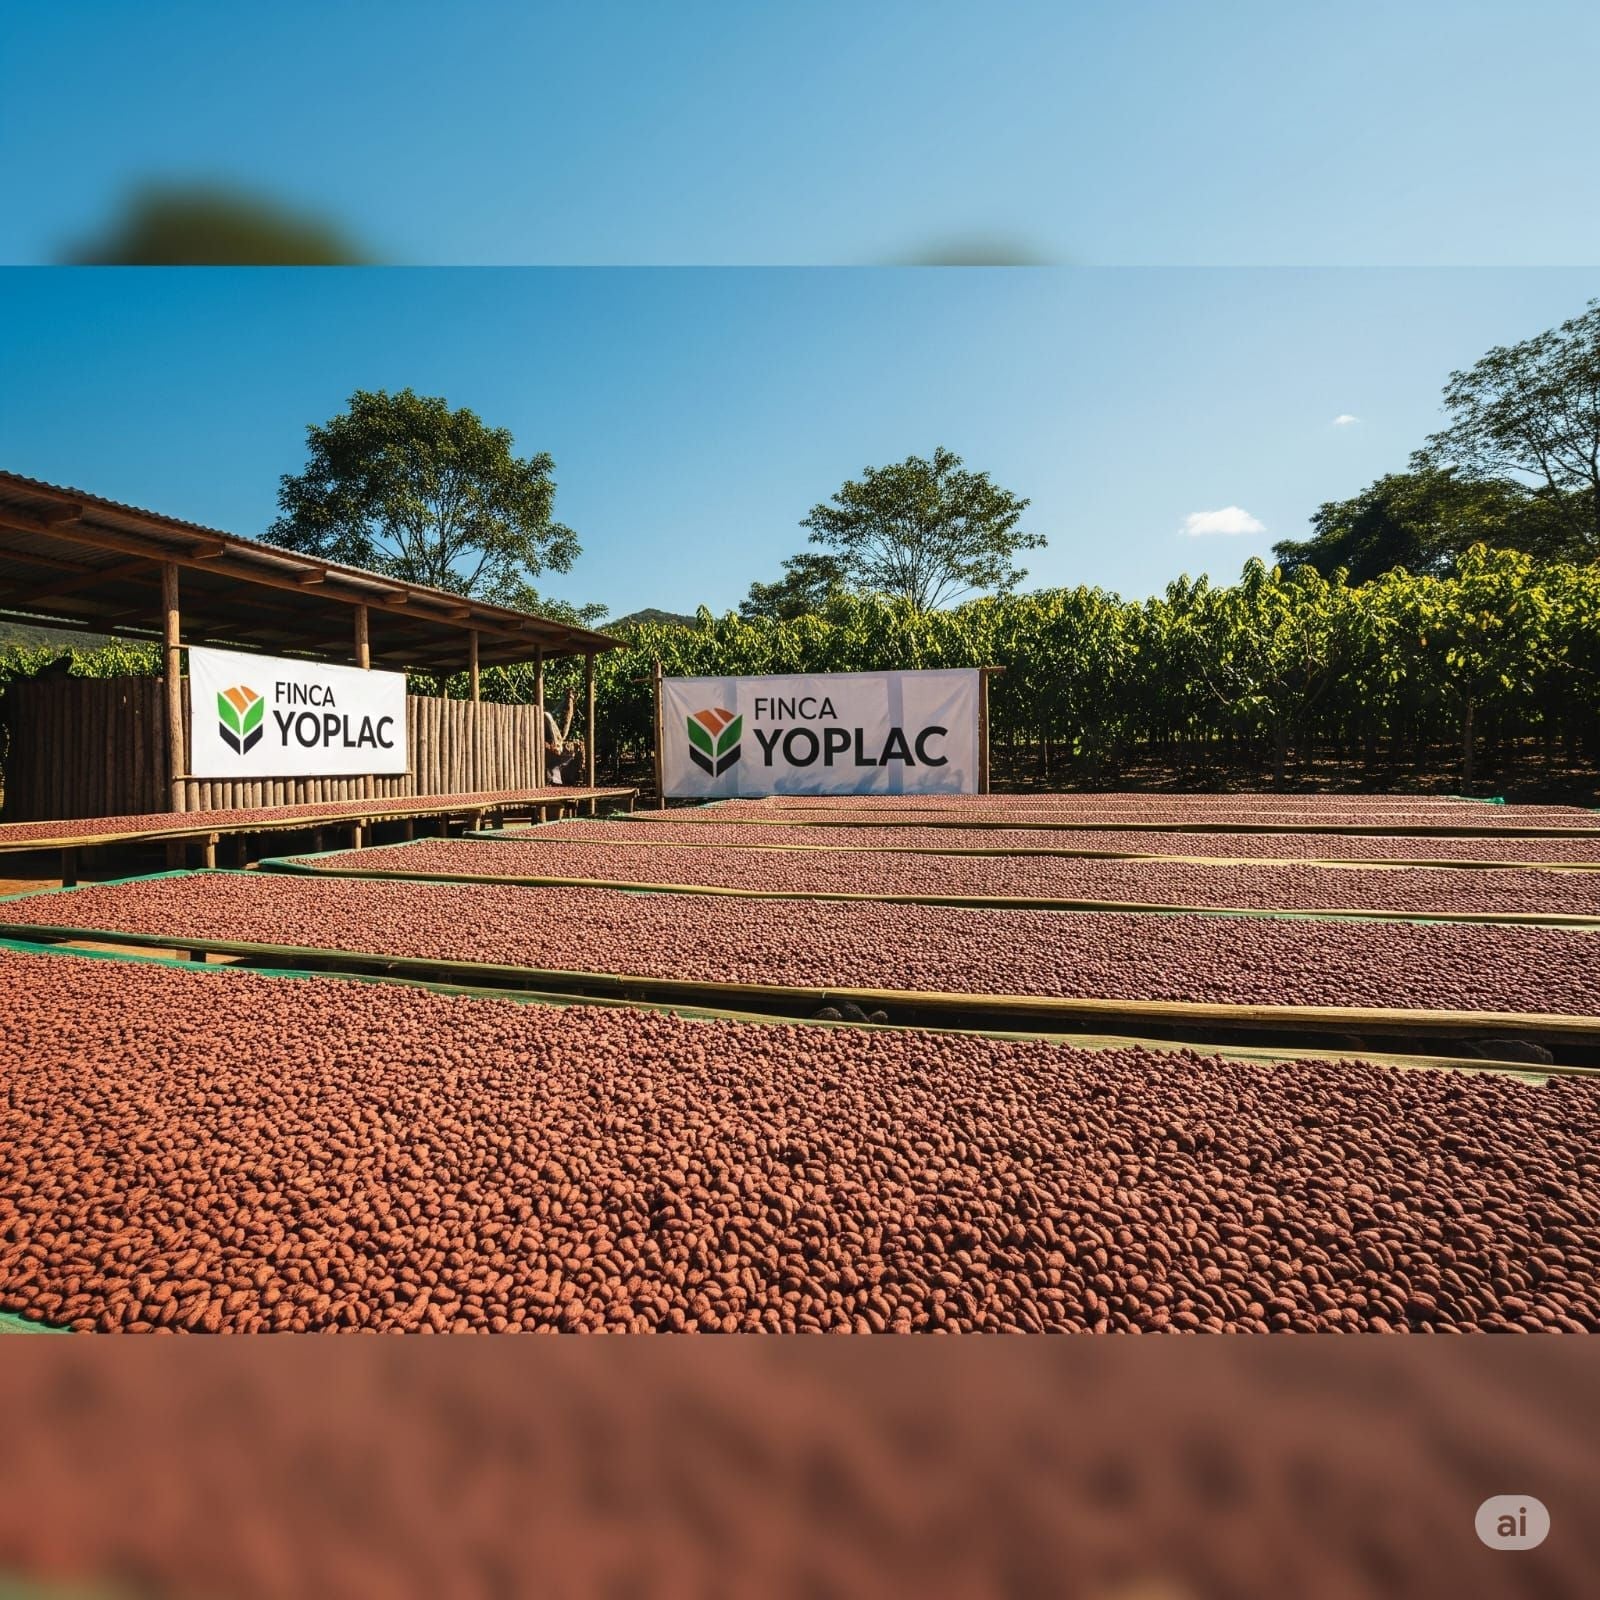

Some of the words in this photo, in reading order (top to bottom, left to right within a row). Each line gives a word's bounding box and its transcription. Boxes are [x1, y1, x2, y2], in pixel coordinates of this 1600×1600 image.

[275, 681, 336, 707] FINCA
[754, 697, 838, 720] FINCA
[272, 710, 395, 749] YOPLAC
[753, 726, 949, 767] YOPLAC
